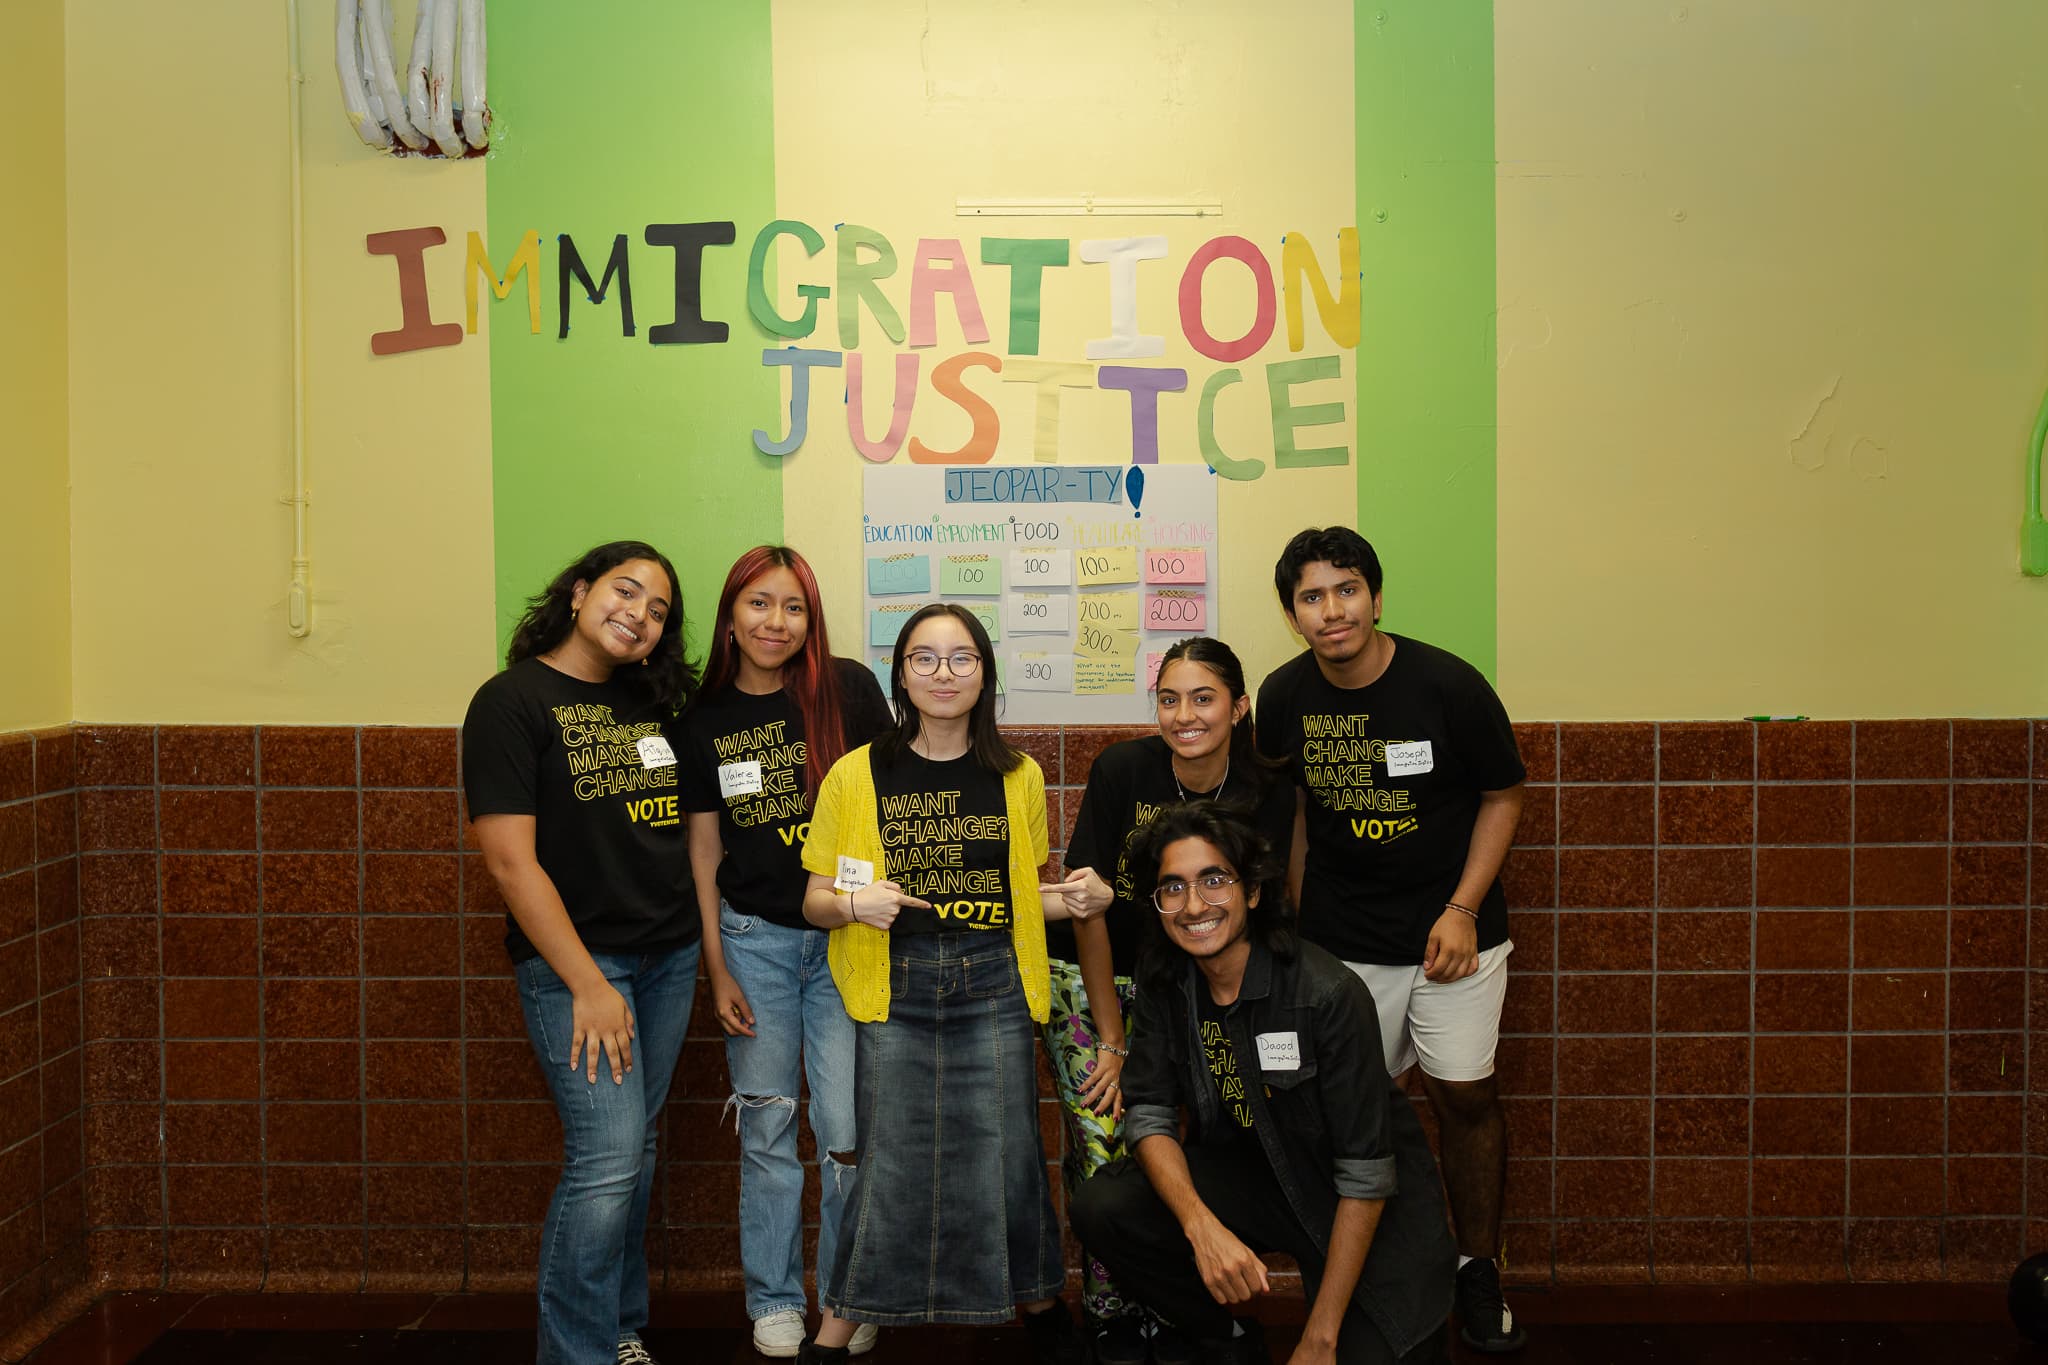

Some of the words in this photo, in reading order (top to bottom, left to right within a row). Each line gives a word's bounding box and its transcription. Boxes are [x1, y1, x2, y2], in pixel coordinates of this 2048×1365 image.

[366, 219, 1362, 361] IMMIGRATION
[864, 524, 933, 543] EDUCATION
[936, 523, 1009, 543] EMPLOYMENT
[1013, 522, 1059, 542] FOOD
[958, 567, 984, 583] 100
[1024, 558, 1050, 574] 100
[1080, 556, 1109, 576] 100
[1150, 557, 1185, 575] 100
[1023, 603, 1047, 618] 200
[1080, 601, 1111, 622] 200
[1150, 599, 1198, 622] 200
[1080, 626, 1112, 652] 300
[1025, 663, 1052, 681] 300
[552, 704, 616, 728] WANT
[1303, 714, 1369, 738] WANT
[714, 720, 786, 758] WANT
[1303, 739, 1404, 763] CHANG
[567, 741, 643, 776] MAKE
[1390, 747, 1427, 761] Joseph
[1304, 764, 1373, 787] MAKE
[625, 795, 679, 823] VOTE
[732, 792, 809, 827] CHAN
[882, 791, 961, 820] WANT
[777, 822, 812, 846] VO
[881, 815, 1008, 847] CHANGE?
[884, 844, 963, 876] MAKE
[933, 900, 1009, 924] VOTE.
